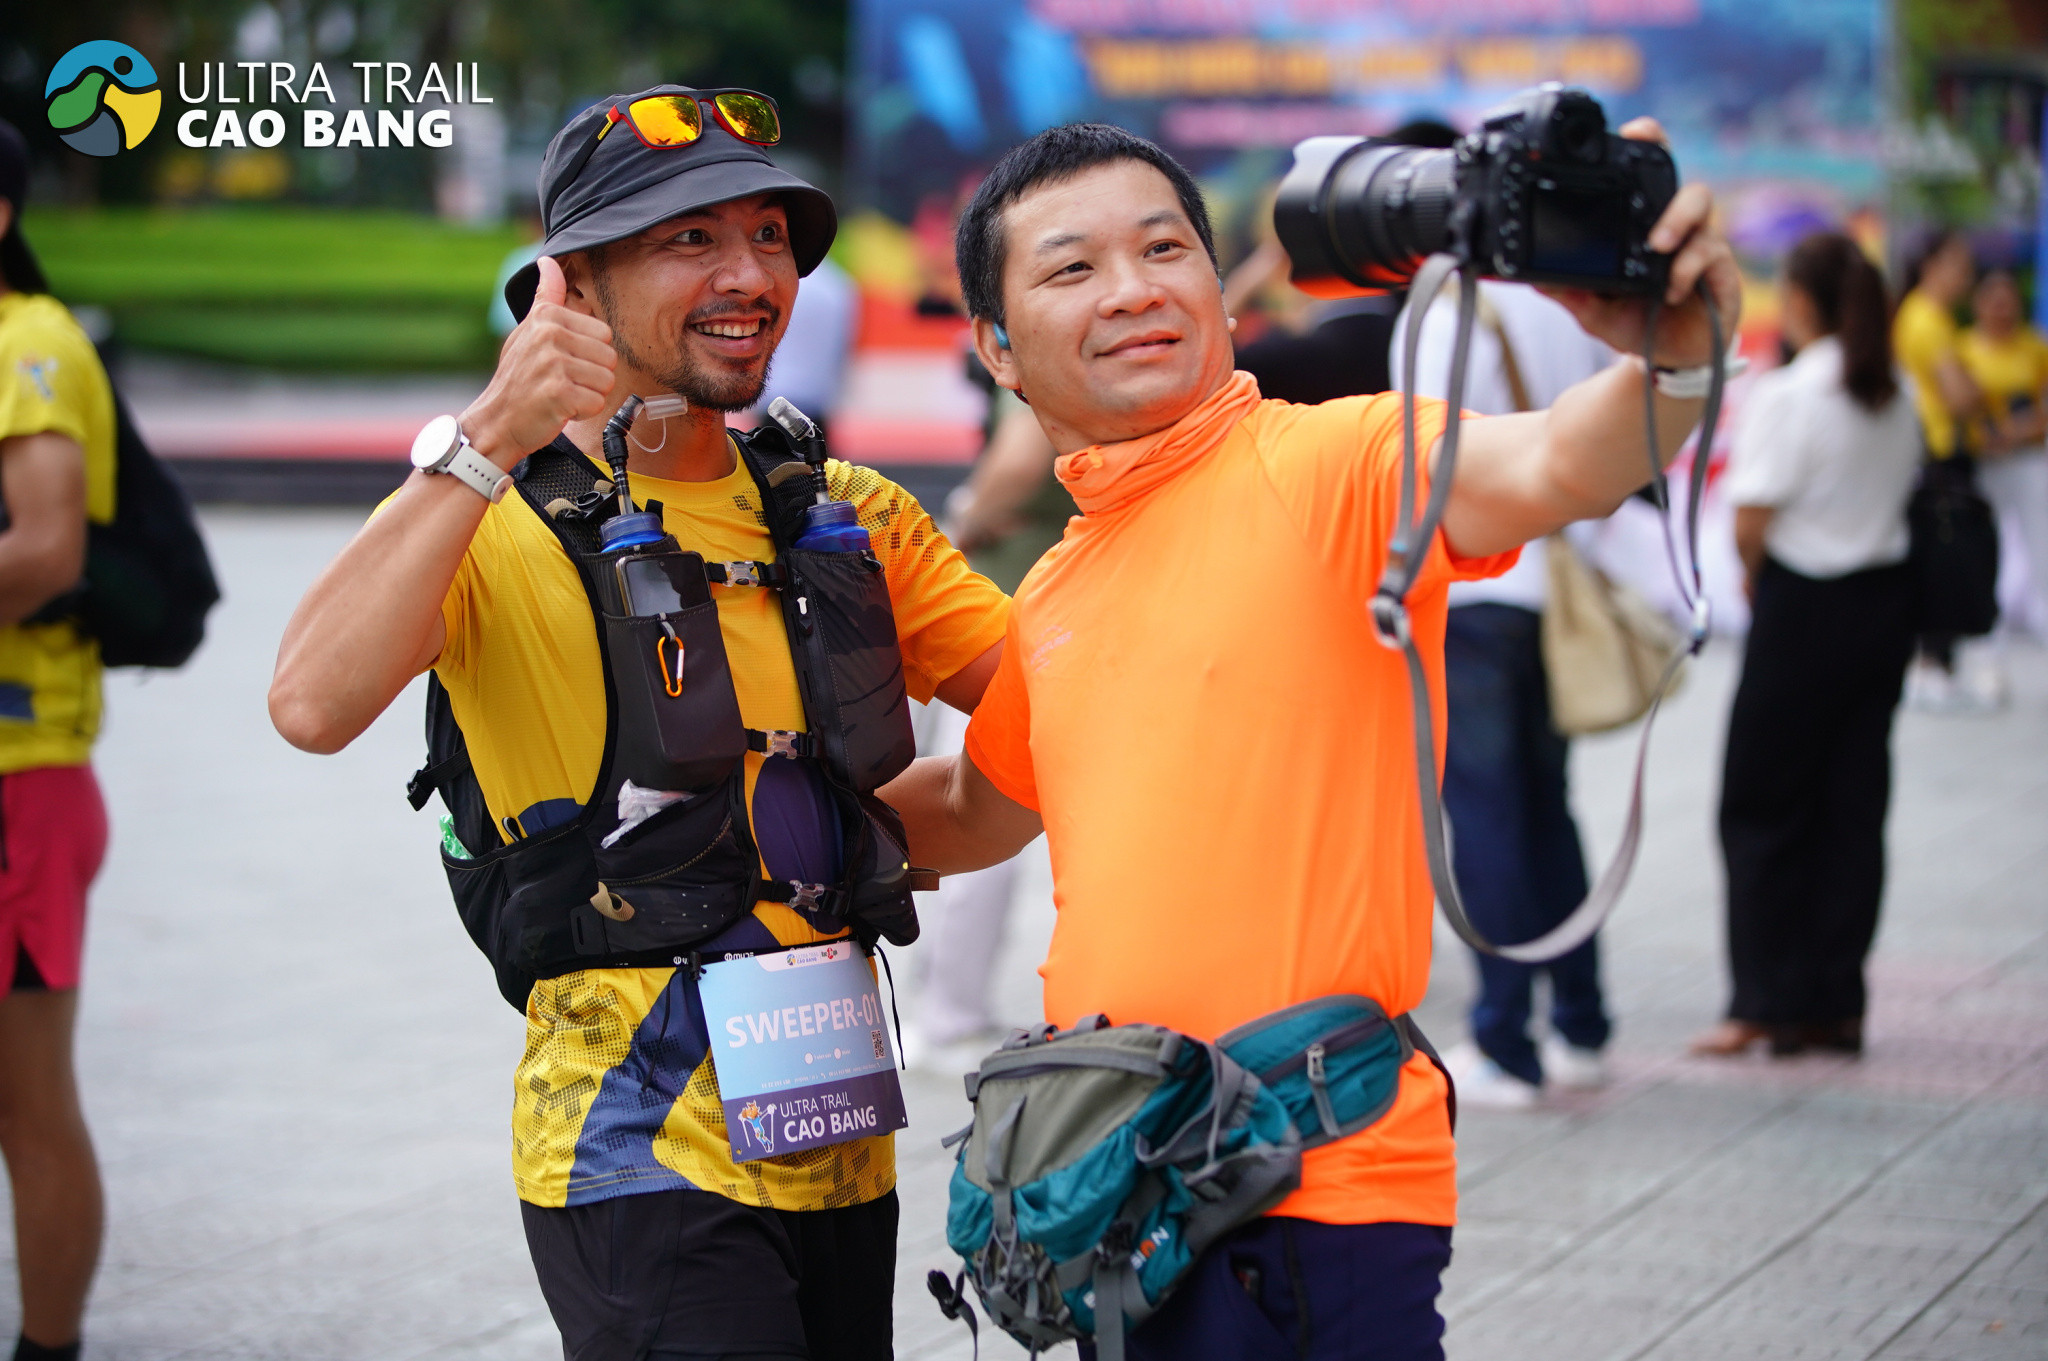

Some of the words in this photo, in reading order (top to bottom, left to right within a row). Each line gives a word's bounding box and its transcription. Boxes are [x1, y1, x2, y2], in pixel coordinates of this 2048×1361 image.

[725, 993, 881, 1048] SWEEPER-01
[780, 1096, 818, 1118] ULTRA
[820, 1091, 852, 1113] TRAIL
[783, 1116, 825, 1143] CAO
[830, 1105, 877, 1135] BANG
